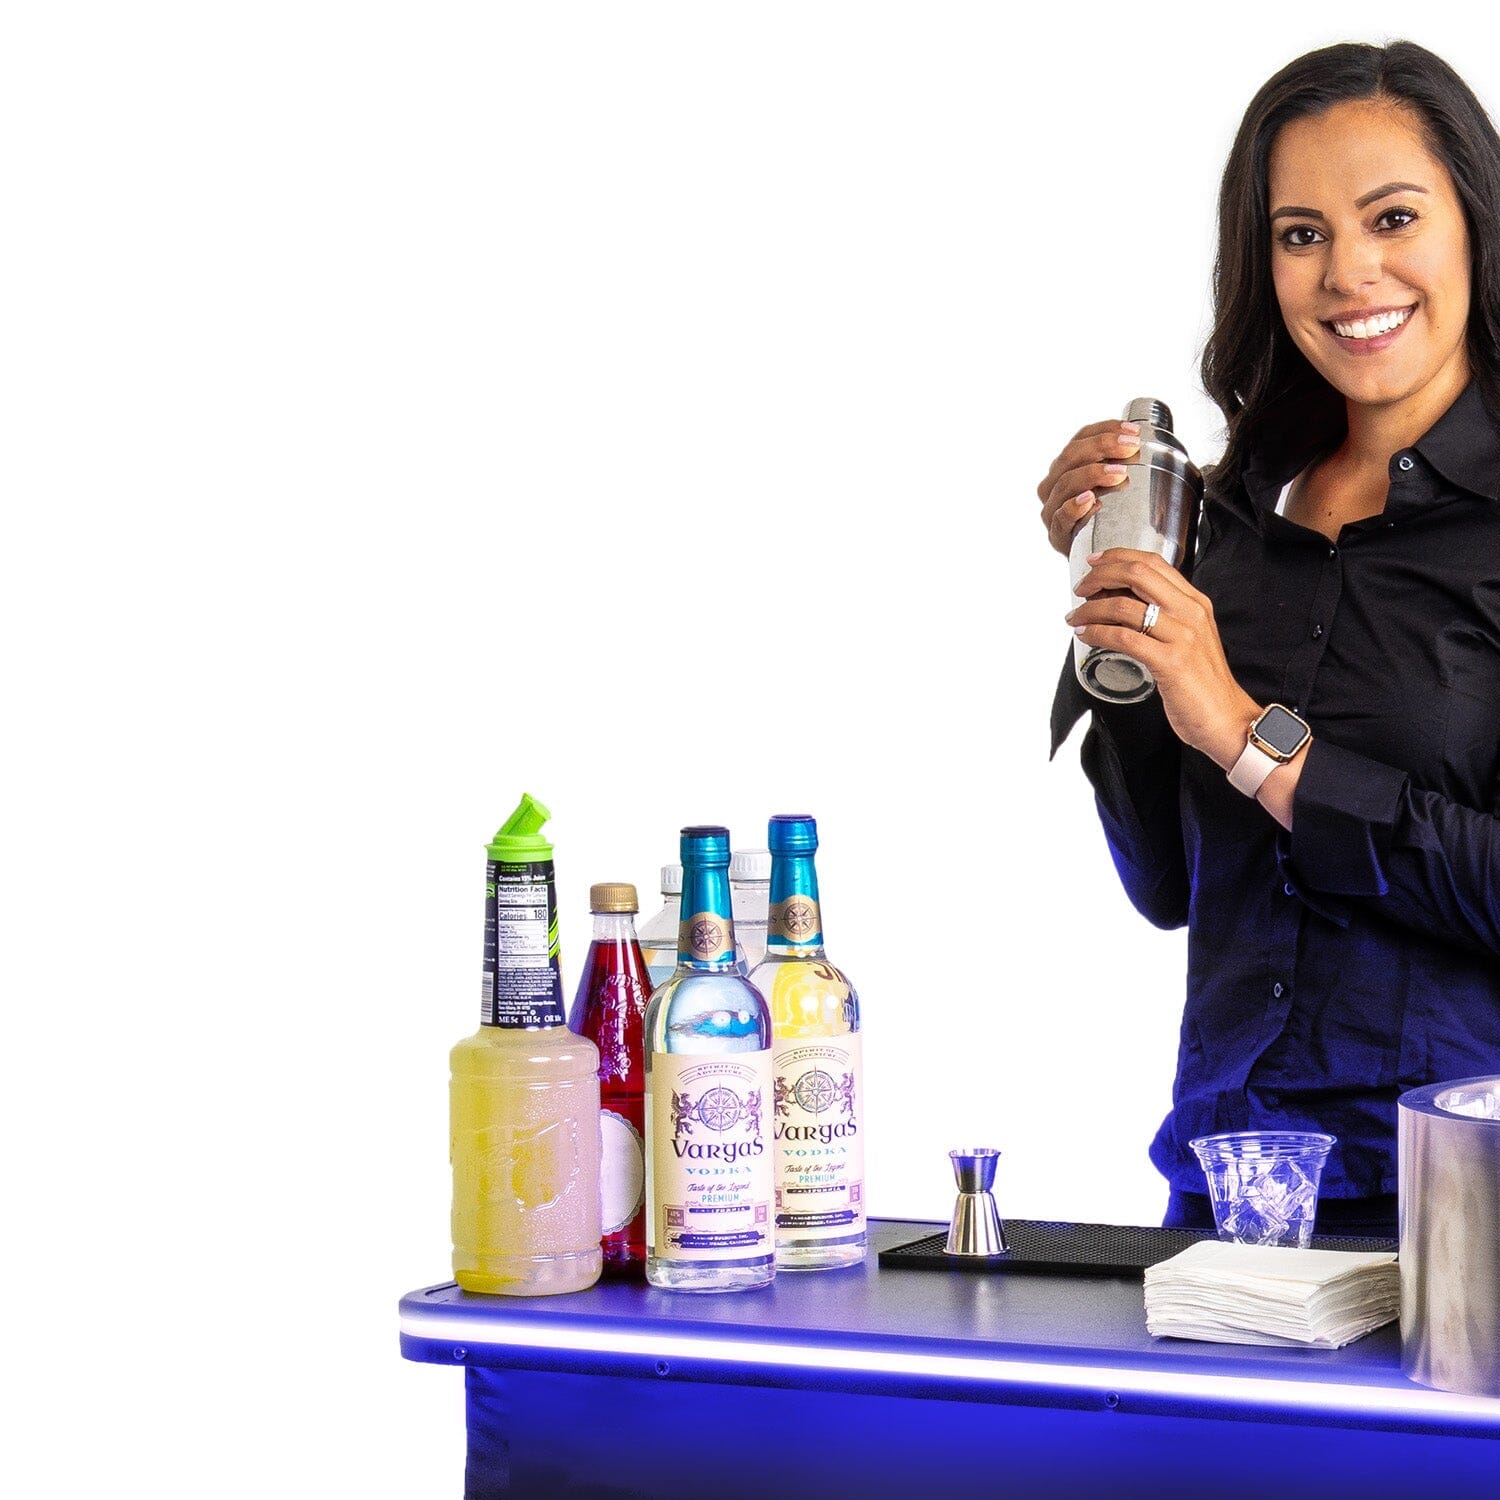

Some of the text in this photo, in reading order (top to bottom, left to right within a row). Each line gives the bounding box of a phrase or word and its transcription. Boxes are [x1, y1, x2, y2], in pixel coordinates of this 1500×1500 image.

[534, 909, 547, 919] 180
[783, 1147, 847, 1156] VODKA
[685, 1166, 752, 1175] VODKA
[785, 1164, 802, 1173] Taste
[804, 1165, 812, 1174] of
[813, 1164, 822, 1172] the
[799, 1174, 835, 1183] PREMIUM
[687, 1183, 705, 1192] Taste
[707, 1184, 715, 1193] of
[728, 1181, 751, 1192] Legend
[702, 1194, 739, 1203] PREMIUM
